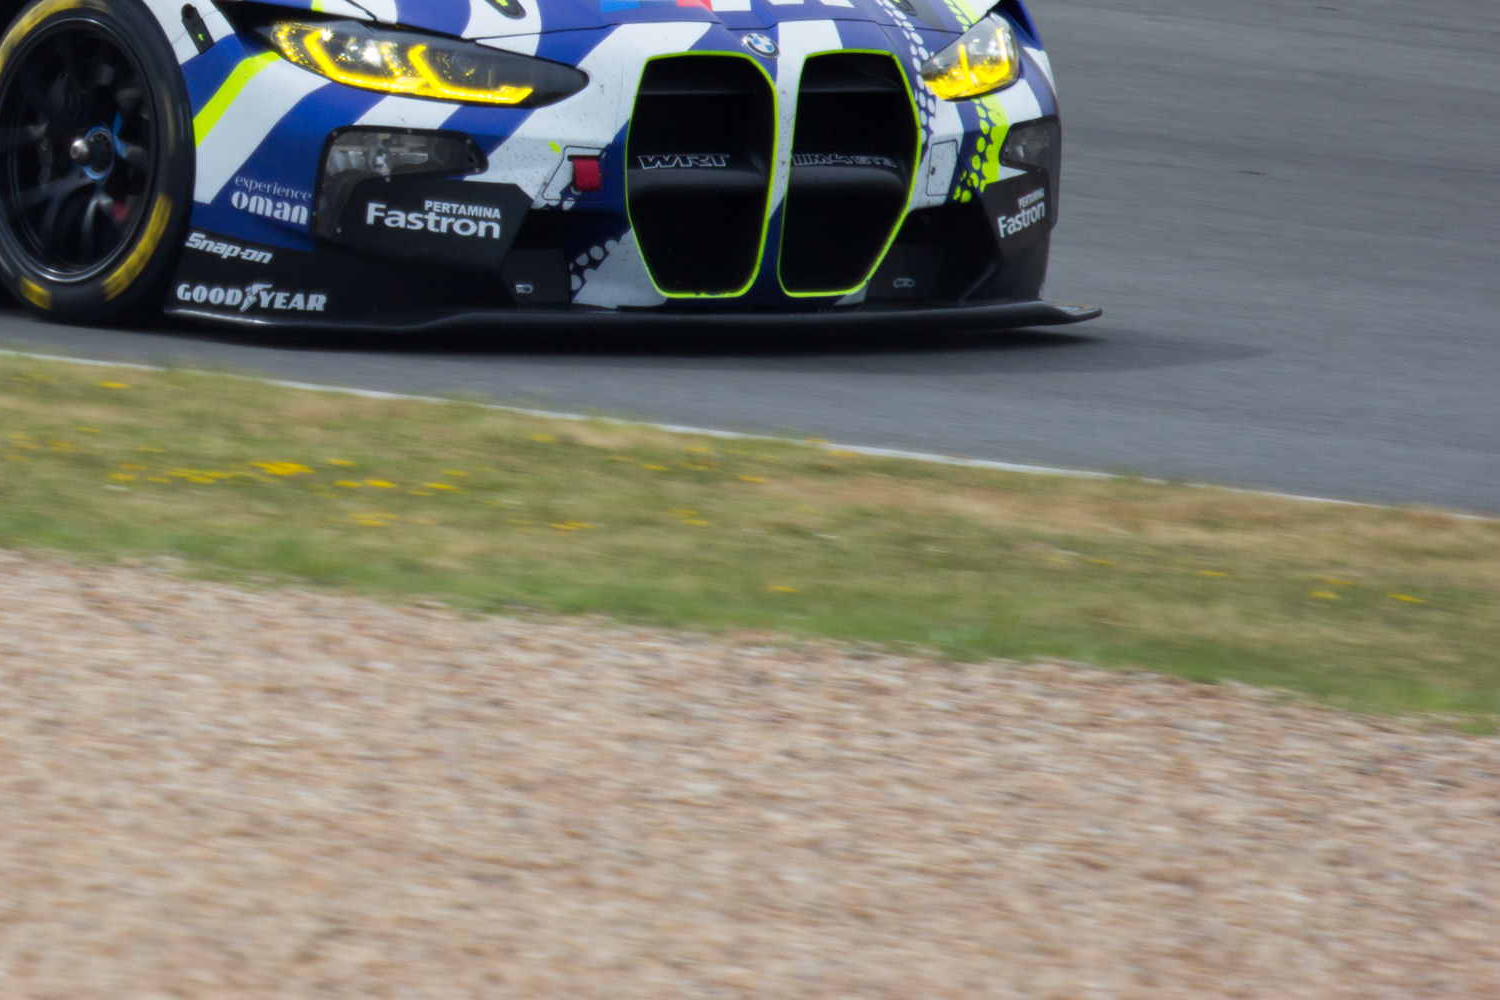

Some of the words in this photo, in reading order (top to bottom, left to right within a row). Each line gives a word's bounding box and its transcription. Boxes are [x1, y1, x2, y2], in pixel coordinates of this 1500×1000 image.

[637, 153, 730, 170] WRT
[235, 175, 312, 202] experience
[231, 190, 309, 226] oman
[366, 202, 501, 239] Fastron
[424, 199, 501, 219] PERTAMINA
[997, 201, 1046, 239] Fastron
[184, 231, 274, 265] Snap-on
[176, 283, 328, 312] GOODYEAR
